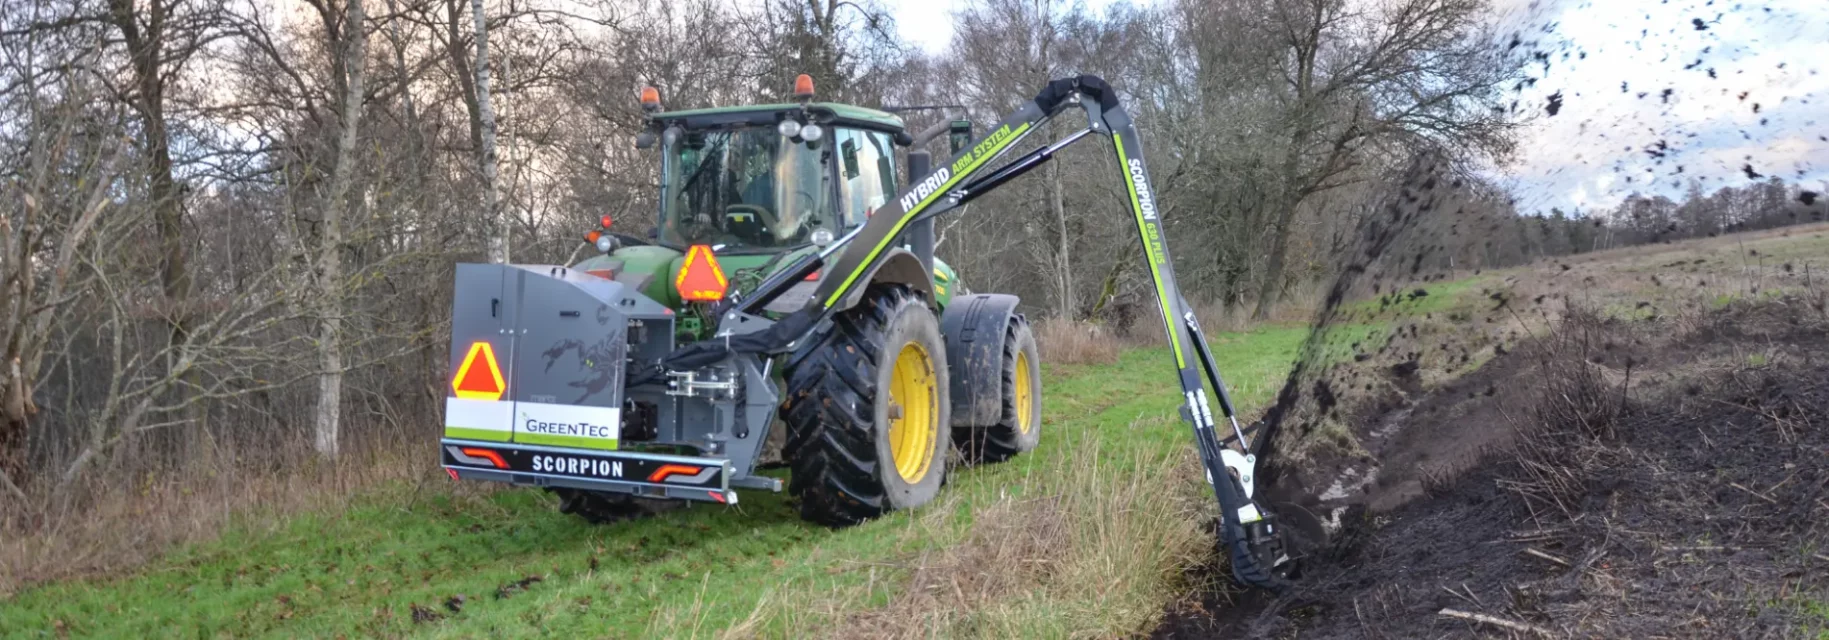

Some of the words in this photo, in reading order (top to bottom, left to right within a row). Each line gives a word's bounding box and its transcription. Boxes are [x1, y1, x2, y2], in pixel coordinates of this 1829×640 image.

[900, 167, 950, 212] HYBRID
[952, 153, 973, 175] ARM
[973, 124, 1011, 158] SYSTEM
[1127, 158, 1156, 220] SCORPION
[1146, 222, 1158, 240] 630
[1151, 241, 1165, 265] PLUS
[532, 455, 622, 477] SCORPION
